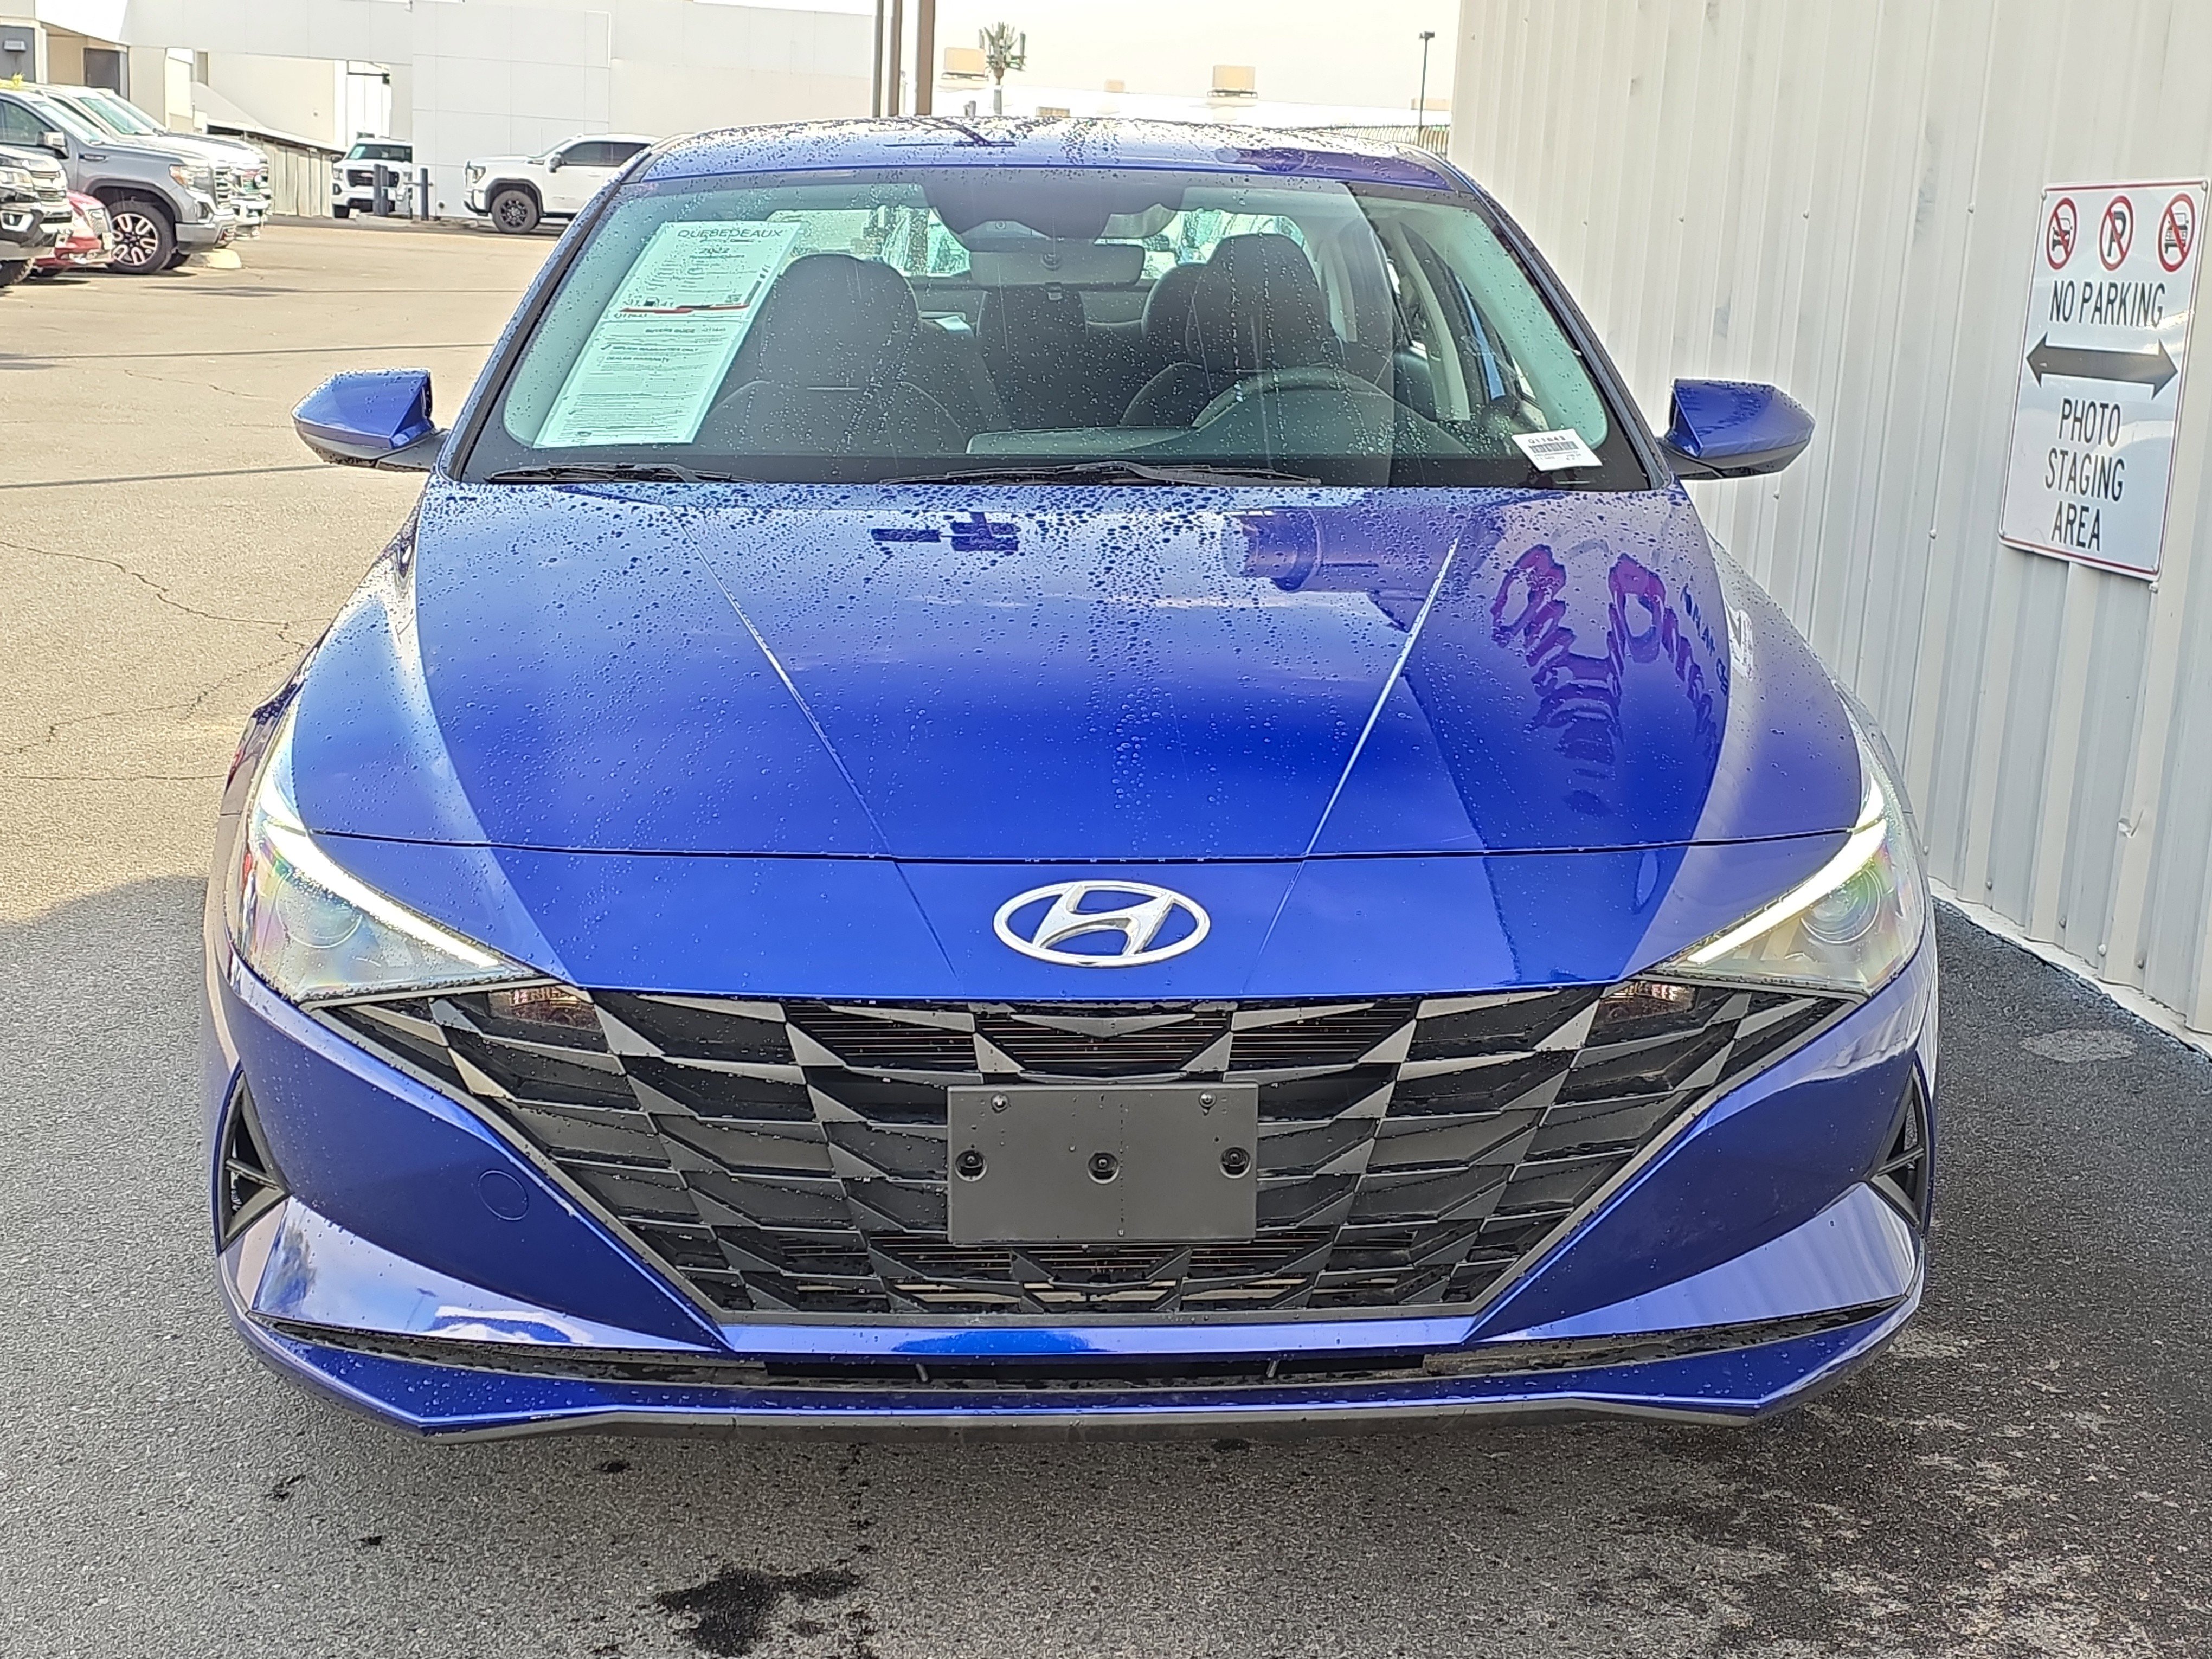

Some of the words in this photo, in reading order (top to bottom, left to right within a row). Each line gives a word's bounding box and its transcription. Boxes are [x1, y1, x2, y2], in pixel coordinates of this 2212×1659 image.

[677, 228, 784, 239] QUEBEDEAUX
[2049, 280, 2076, 324] NO
[2078, 279, 2166, 329] PARKING
[2058, 398, 2121, 447] PHOTO
[2044, 448, 2125, 502] STAGING
[2051, 502, 2101, 551] AREA
